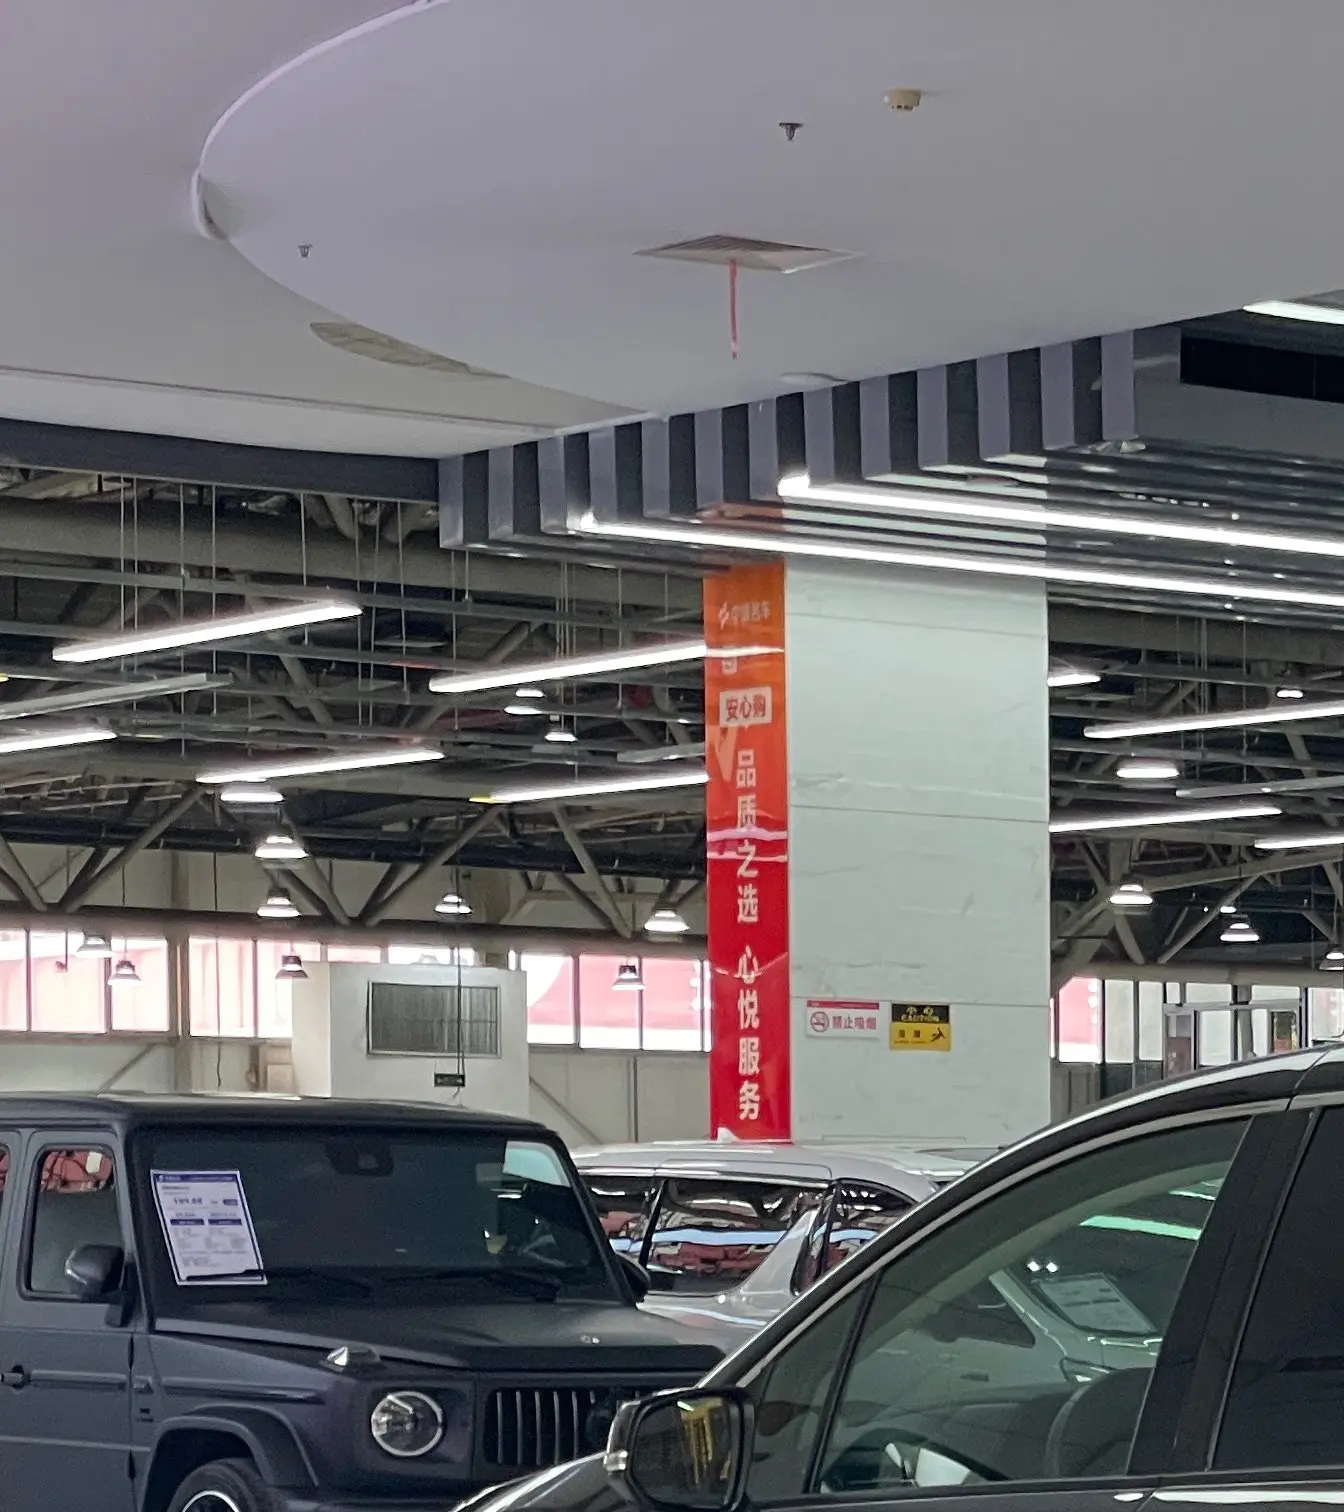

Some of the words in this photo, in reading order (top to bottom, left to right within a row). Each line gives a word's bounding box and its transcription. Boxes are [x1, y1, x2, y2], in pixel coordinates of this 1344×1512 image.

[725, 693, 767, 722] 安心购
[733, 942, 762, 1124] 心悦服务
